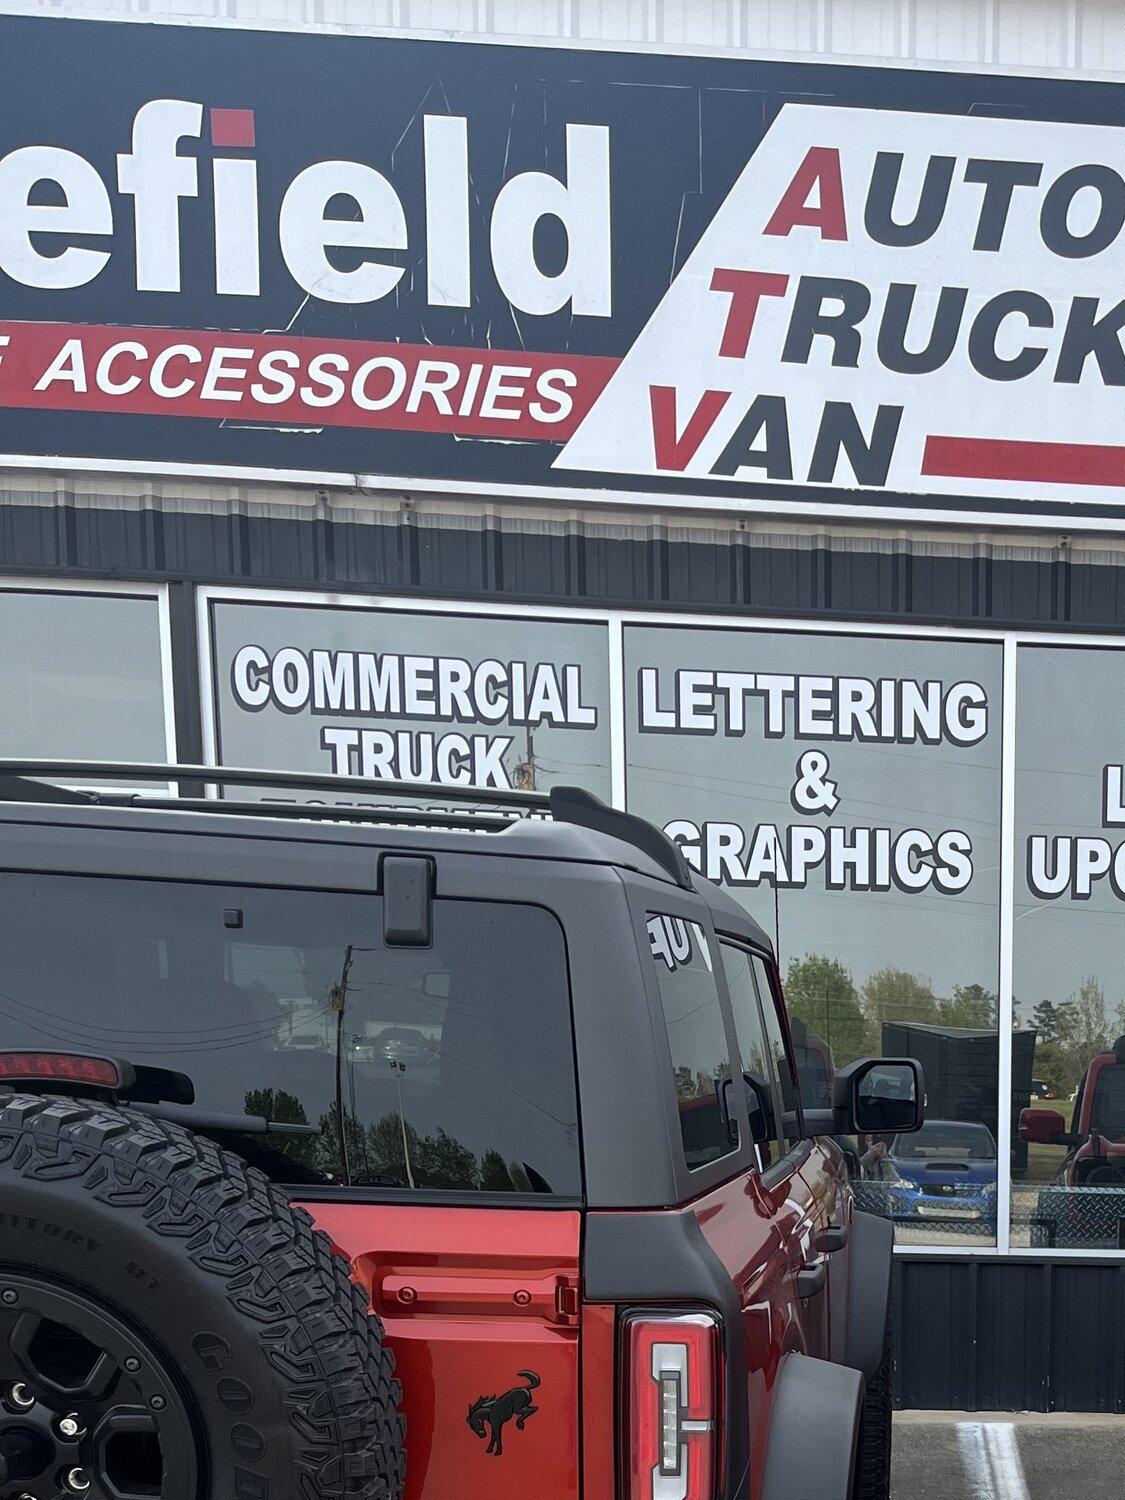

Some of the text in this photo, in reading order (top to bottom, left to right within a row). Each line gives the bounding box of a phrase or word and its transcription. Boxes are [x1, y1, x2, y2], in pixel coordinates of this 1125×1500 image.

[33, 338, 577, 424] ACCESSORIES
[649, 384, 904, 487] VAN
[232, 644, 598, 730] COMMERCIAL
[637, 667, 989, 748] LETTERING
[320, 726, 514, 791] TRUCK
[790, 748, 840, 816] &
[662, 819, 974, 894] GRAPHICS
